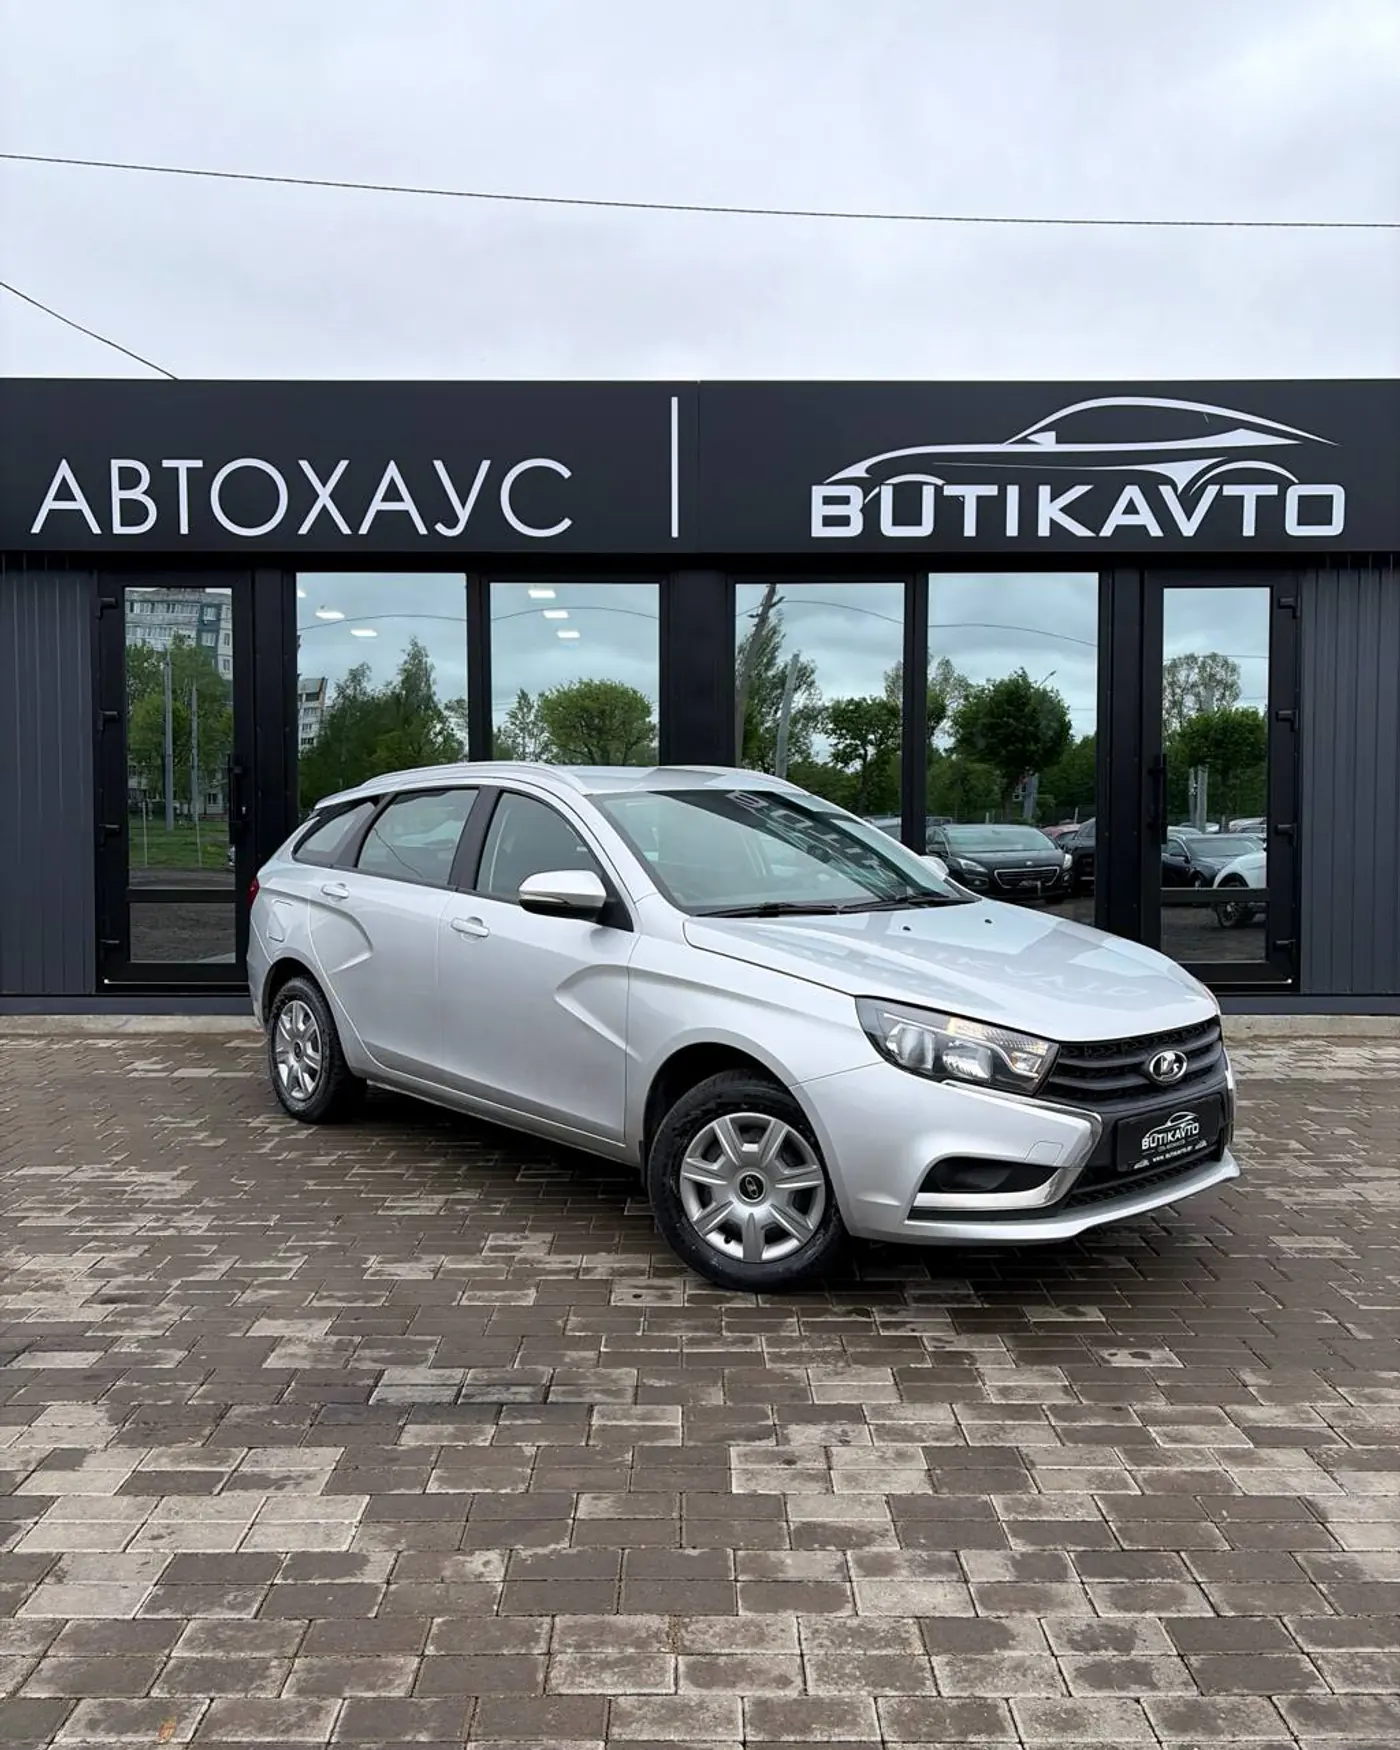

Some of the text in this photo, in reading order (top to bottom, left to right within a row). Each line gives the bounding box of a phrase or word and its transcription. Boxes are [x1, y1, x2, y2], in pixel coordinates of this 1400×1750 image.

[30, 457, 574, 538] АВТОХАУС
[809, 483, 1347, 538] BUTIKAVTO
[1141, 1122, 1200, 1151] BUTIKAVTO
